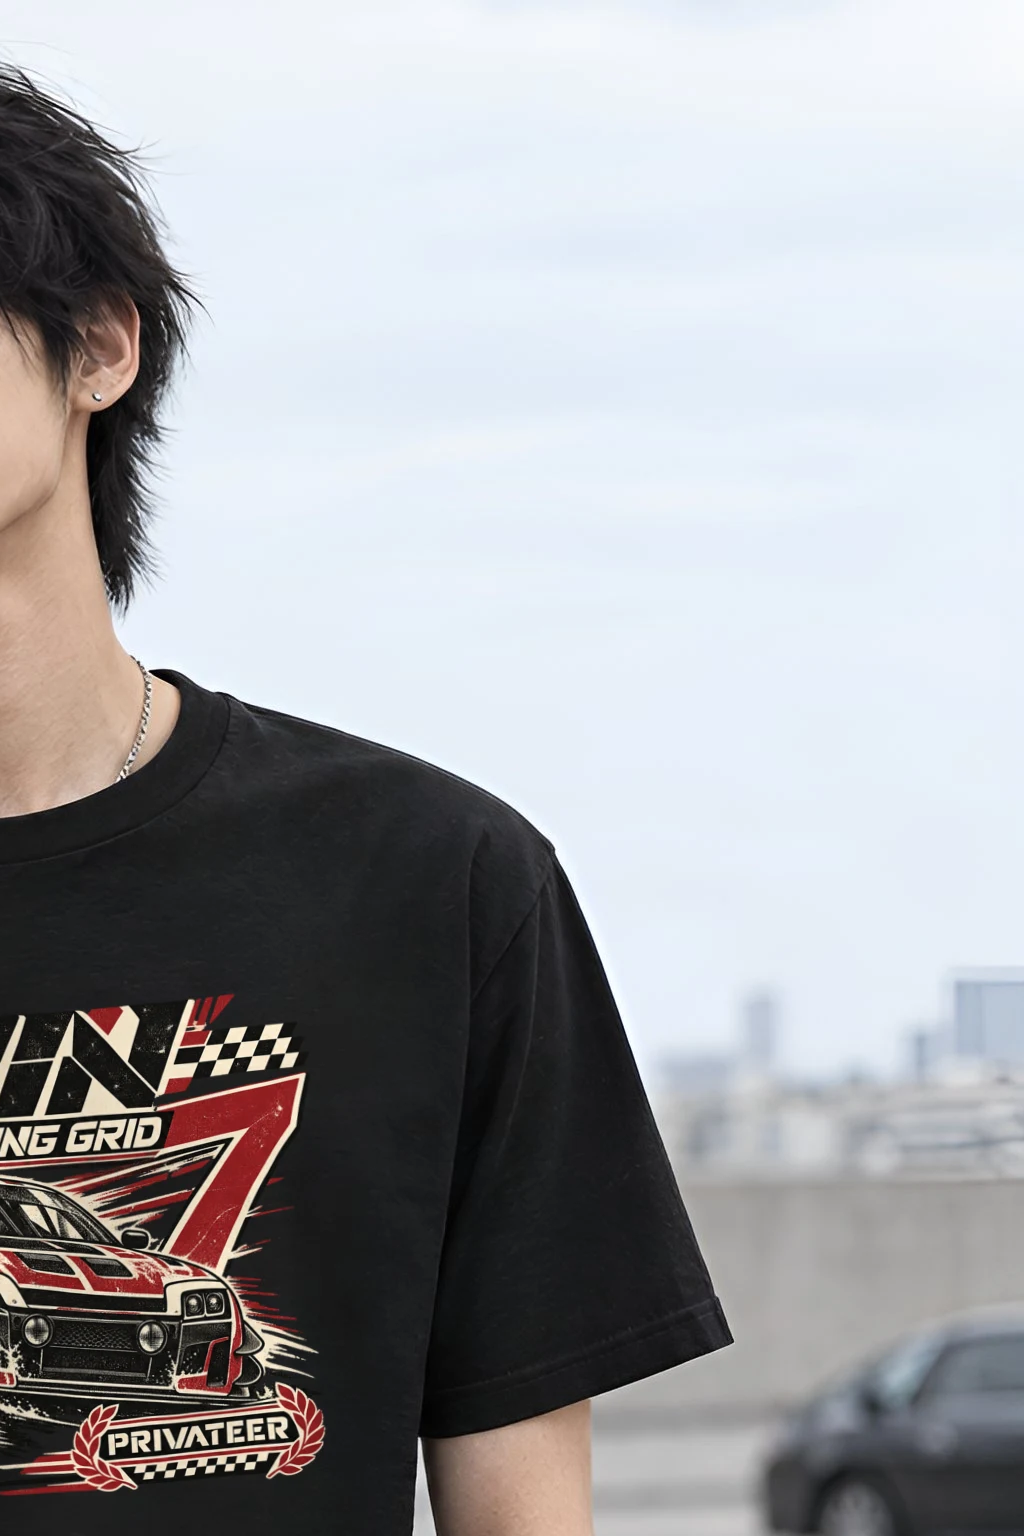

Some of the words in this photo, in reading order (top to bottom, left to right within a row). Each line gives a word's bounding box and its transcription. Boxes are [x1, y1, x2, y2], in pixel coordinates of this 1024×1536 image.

[64, 1116, 163, 1154] GRID
[156, 1072, 306, 1277] 7
[107, 1415, 289, 1456] PRIVATEER
